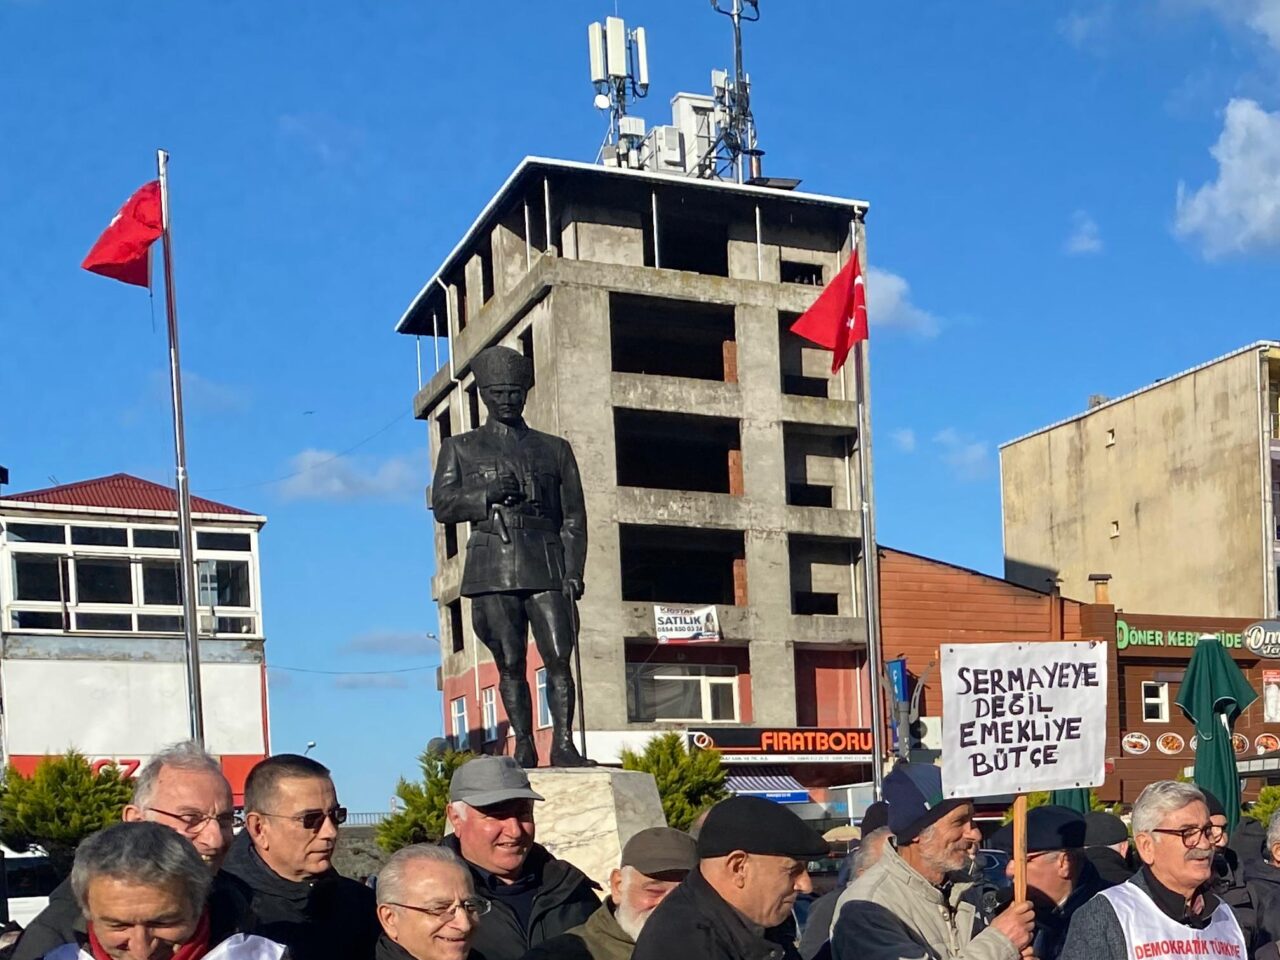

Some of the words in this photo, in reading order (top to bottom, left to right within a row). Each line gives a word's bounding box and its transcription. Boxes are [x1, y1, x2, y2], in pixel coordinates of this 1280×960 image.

[657, 616, 702, 626] SATILIK
[1116, 620, 1164, 650] DÖNER
[956, 661, 1099, 696] SERMAYEYE
[971, 691, 1054, 719] DEĞİL
[761, 731, 872, 751] FIRATBORU
[959, 714, 1082, 749] EMEKLİYE
[967, 744, 1059, 777] BÜTÇE
